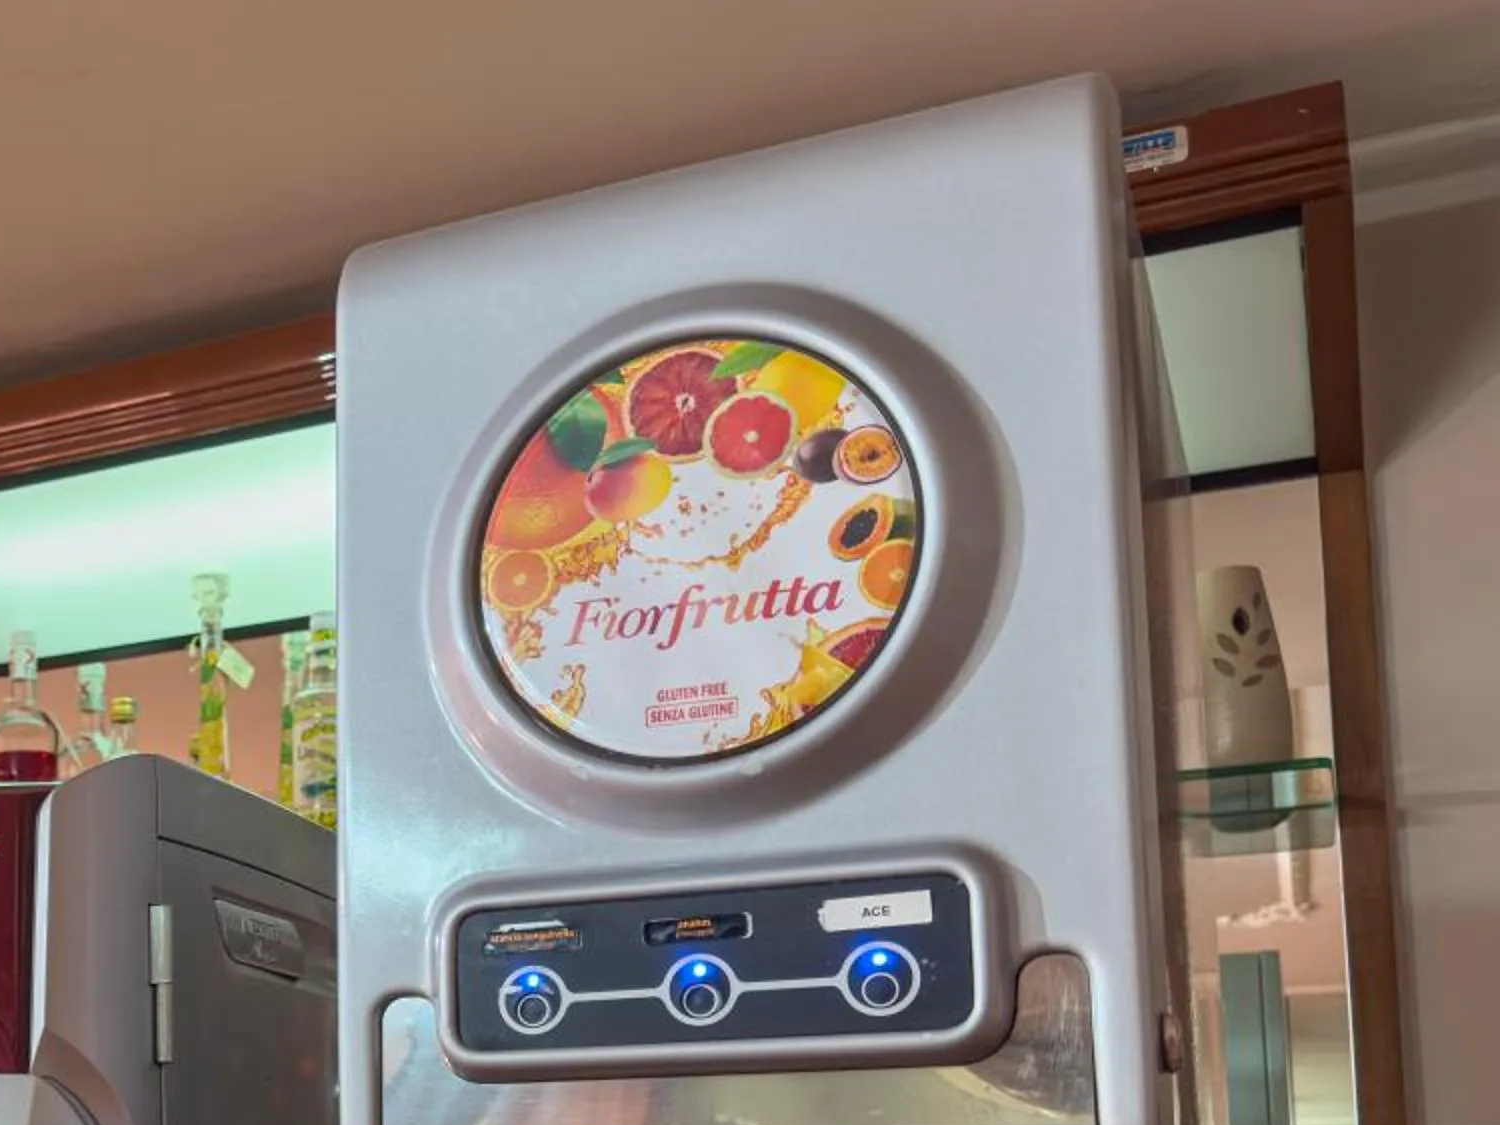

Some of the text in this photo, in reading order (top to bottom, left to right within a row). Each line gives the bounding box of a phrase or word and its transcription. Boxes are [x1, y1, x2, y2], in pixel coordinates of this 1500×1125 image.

[564, 575, 845, 651] Fiorfrutta
[656, 682, 729, 702] GLUTEN FREE
[649, 701, 735, 724] SENZA GLUTINE
